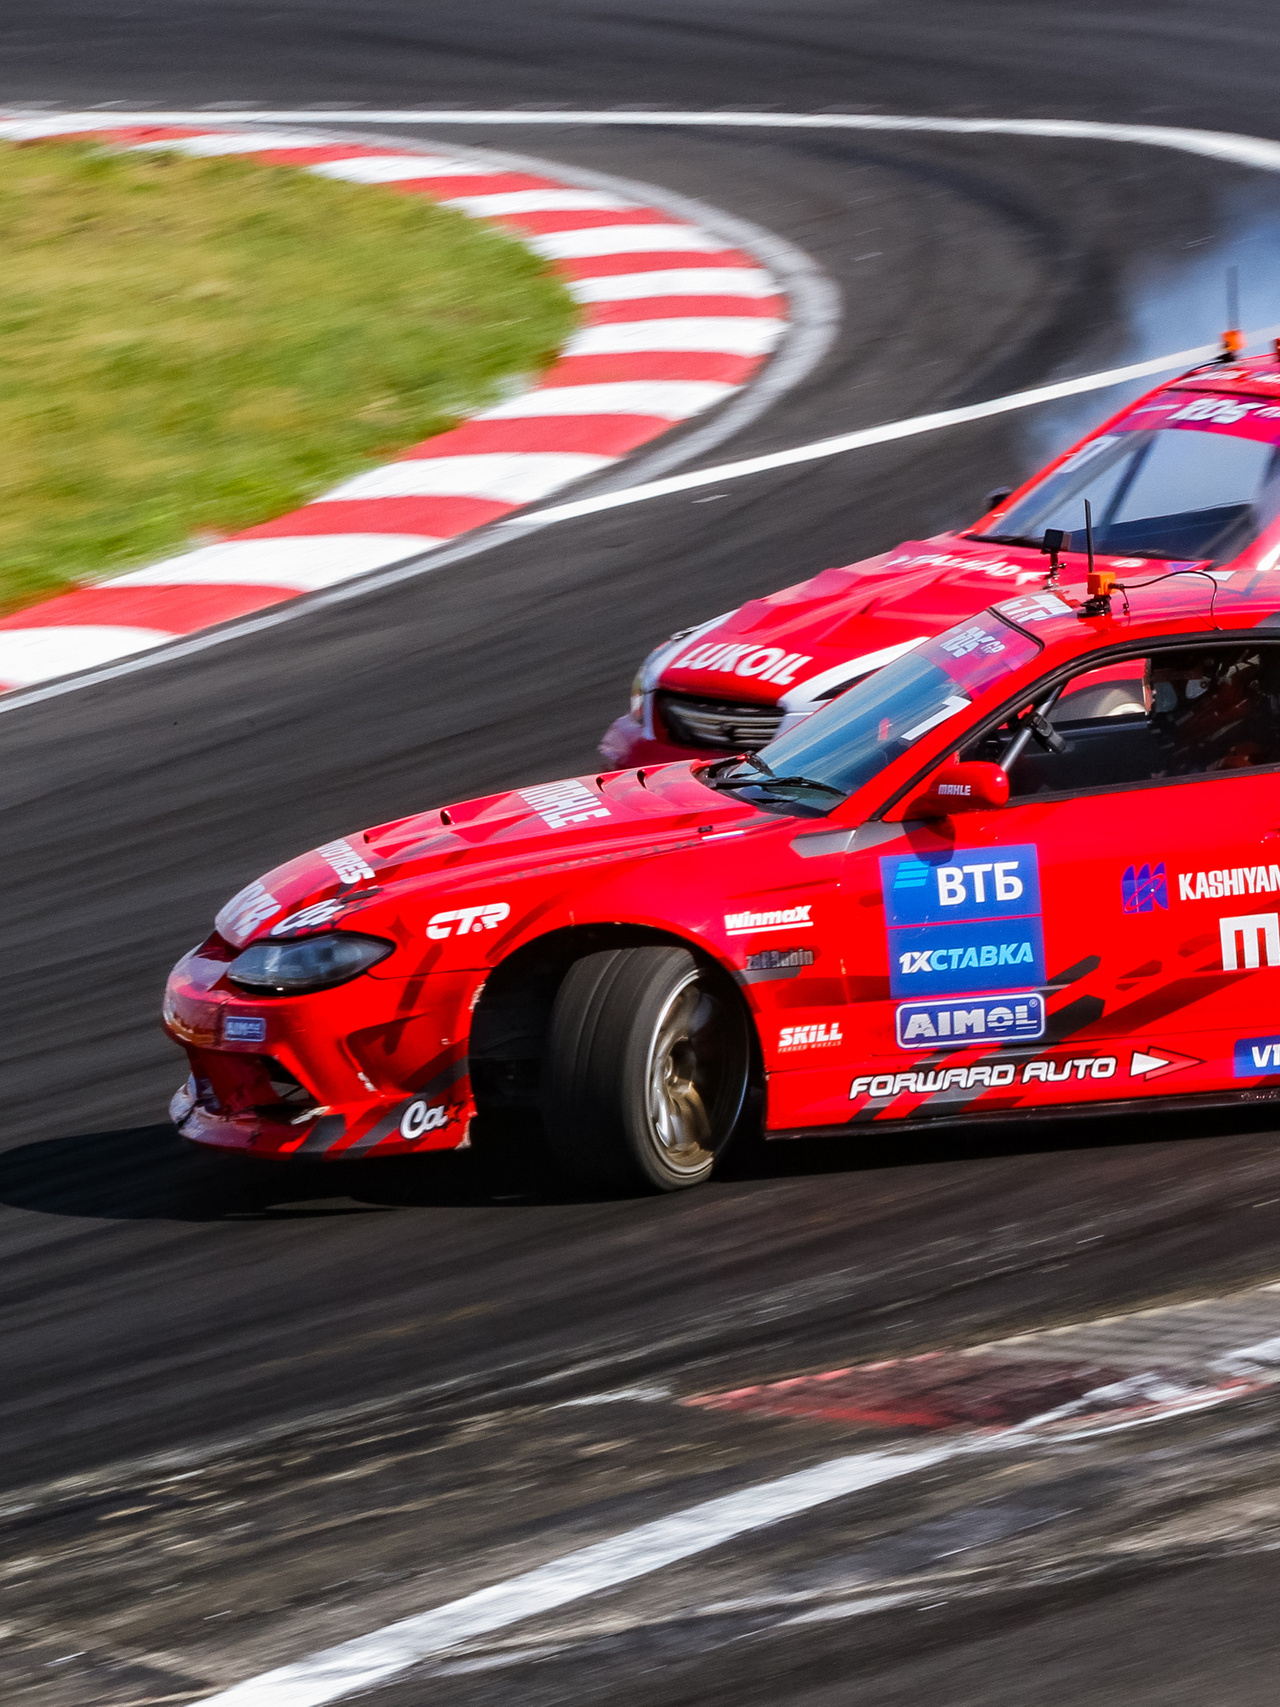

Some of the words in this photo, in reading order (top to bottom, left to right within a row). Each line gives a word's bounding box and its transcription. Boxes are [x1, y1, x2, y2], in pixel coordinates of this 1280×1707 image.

[670, 643, 813, 686] LUKOIL
[517, 779, 612, 830] MAHLE
[938, 784, 971, 796] MAHLE
[937, 861, 1025, 906] ВТБ
[426, 902, 511, 939] CTR
[778, 1022, 843, 1048] SKILL
[902, 1004, 1037, 1039] AIMOL
[849, 1062, 1016, 1100] FORWARD
[1021, 1056, 1117, 1084] AUTO
